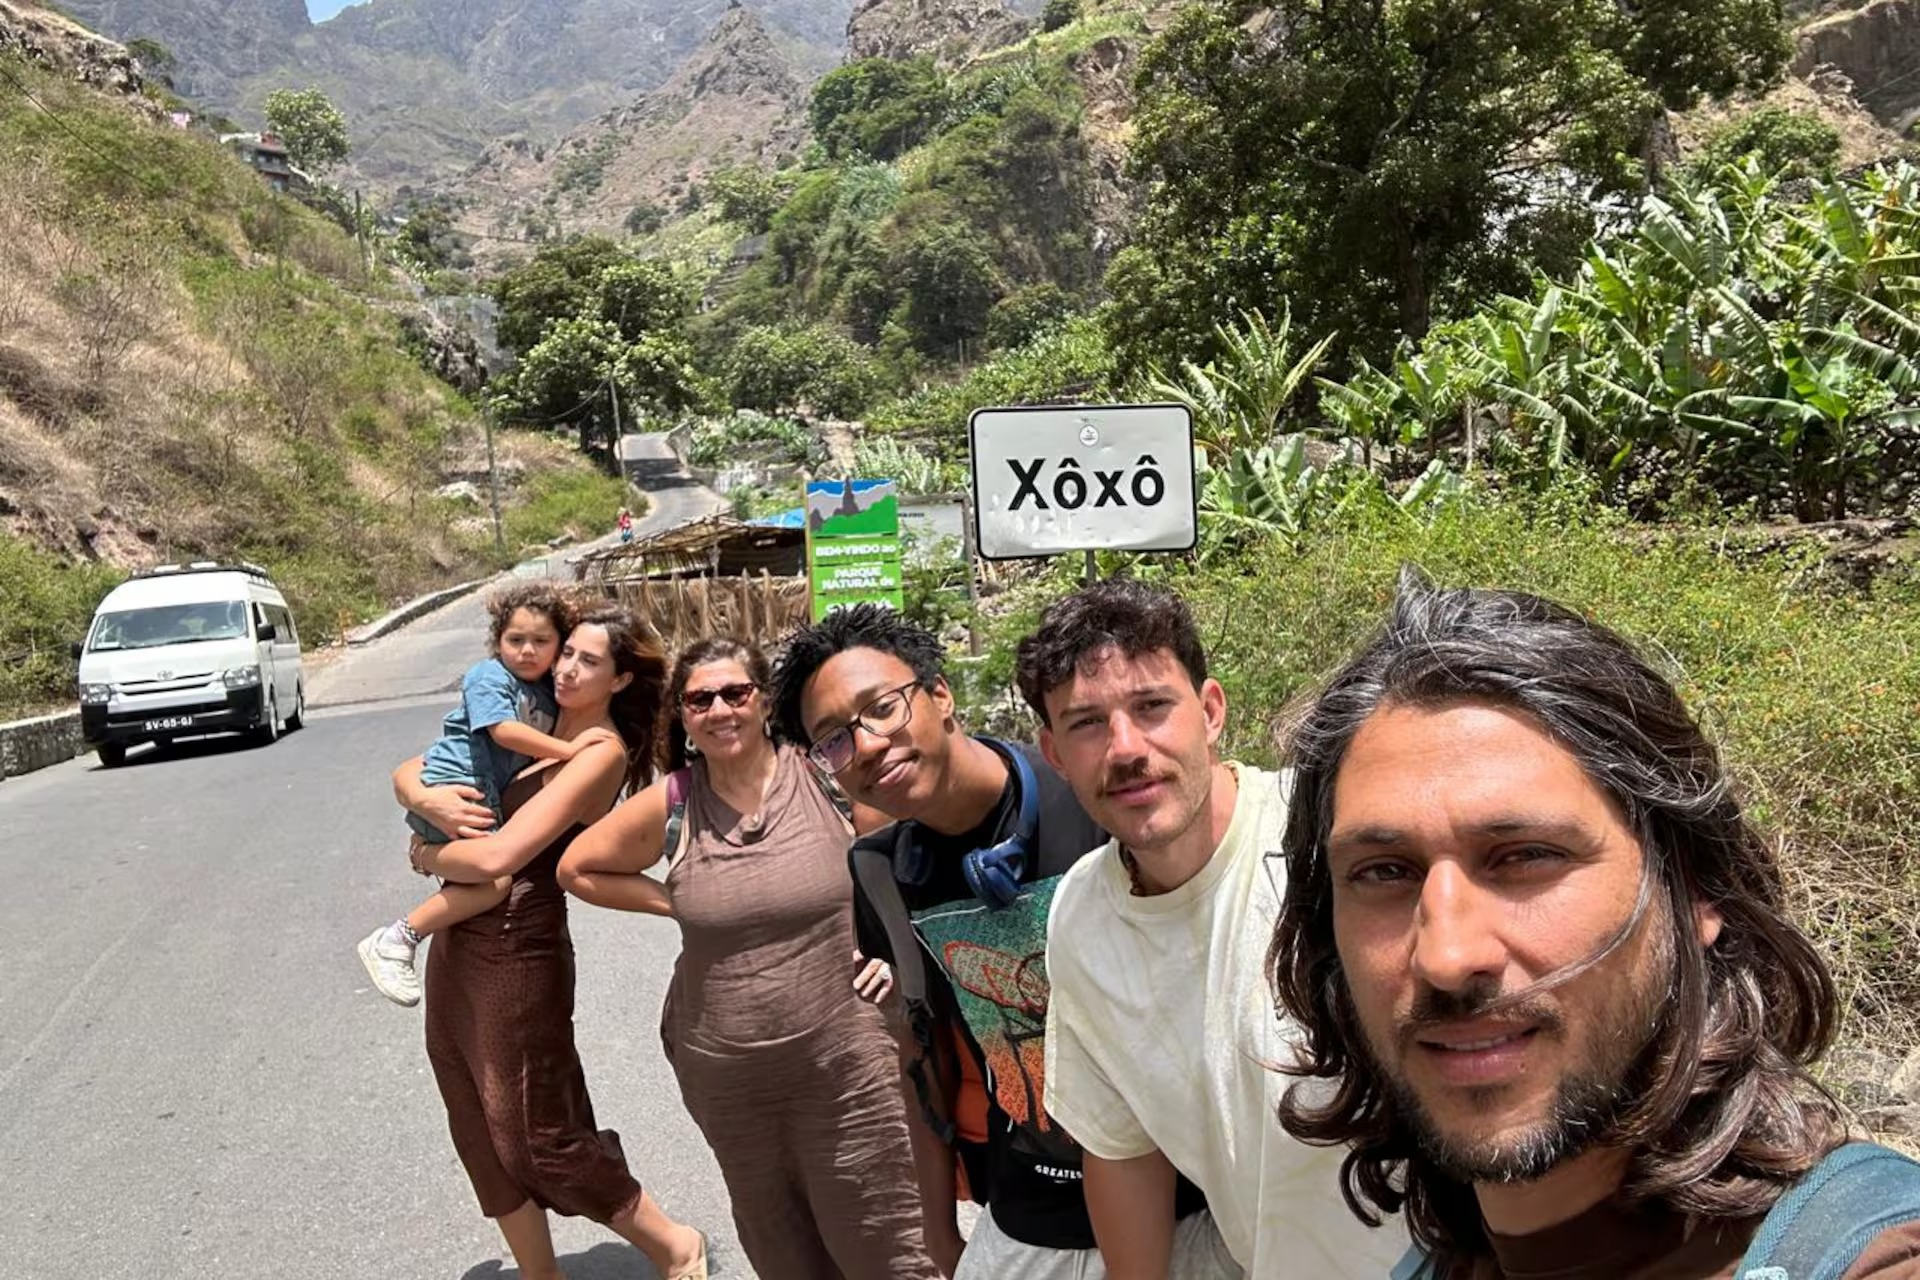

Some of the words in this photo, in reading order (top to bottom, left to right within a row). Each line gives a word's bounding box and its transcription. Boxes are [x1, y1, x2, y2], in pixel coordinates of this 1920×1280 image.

[1006, 454, 1165, 511] Xôxô
[815, 545, 880, 556] BEM-VINDO
[834, 567, 881, 578] PARQUE
[822, 577, 879, 590] NATURAL
